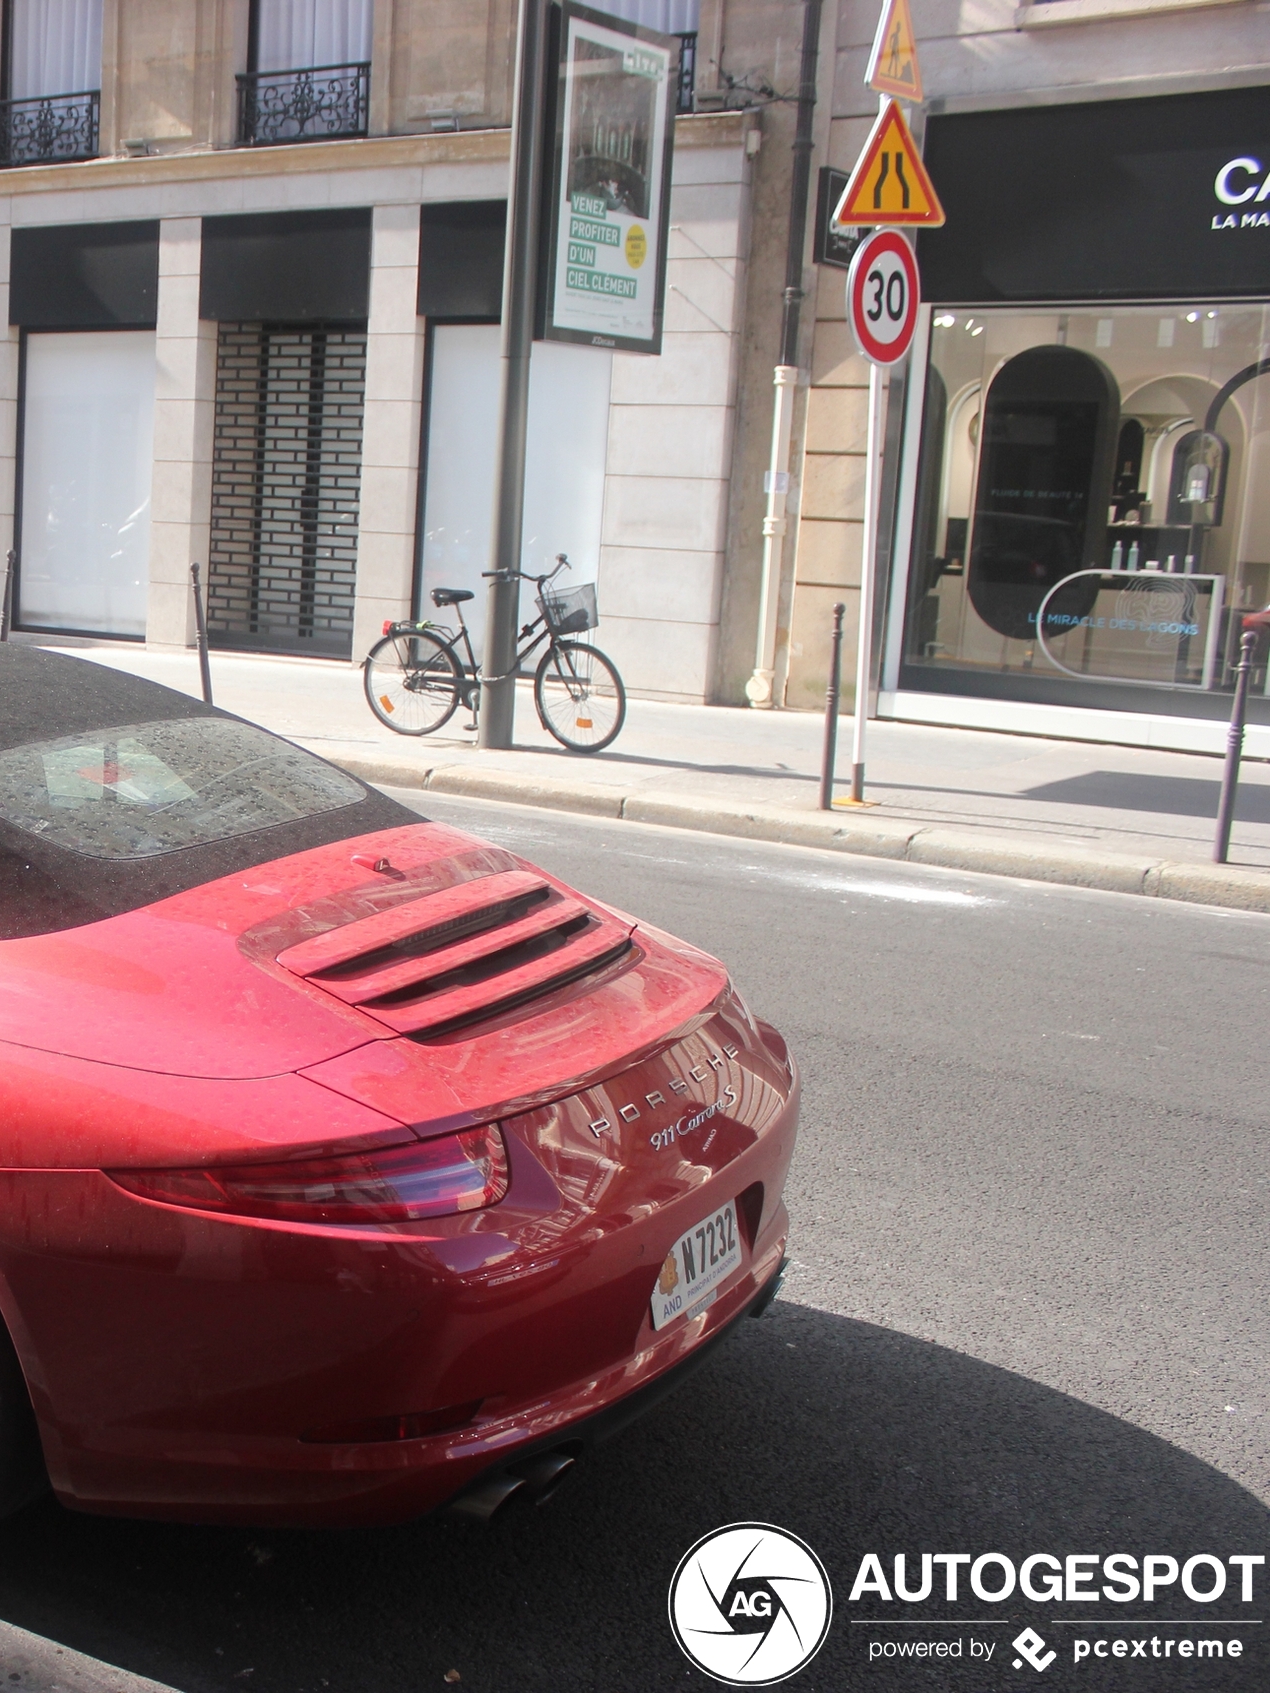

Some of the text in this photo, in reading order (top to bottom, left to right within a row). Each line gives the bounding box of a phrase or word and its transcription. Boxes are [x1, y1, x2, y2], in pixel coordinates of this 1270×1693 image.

[573, 195, 605, 216] VENEZ
[571, 220, 618, 244] PROFITER
[1211, 213, 1237, 230] LA
[570, 246, 594, 263] D'UN
[568, 270, 636, 296] CIEL CLÉMENT
[866, 269, 905, 322] 30
[1047, 613, 1105, 628] MIRACLE
[1109, 618, 1135, 632] DES
[1140, 622, 1199, 636] LAGONS
[589, 1043, 739, 1138] PORSCHE
[650, 1084, 738, 1151] 911 Carrera S
[687, 1273, 713, 1299] PRINCIPAT
[663, 1295, 683, 1319] AND
